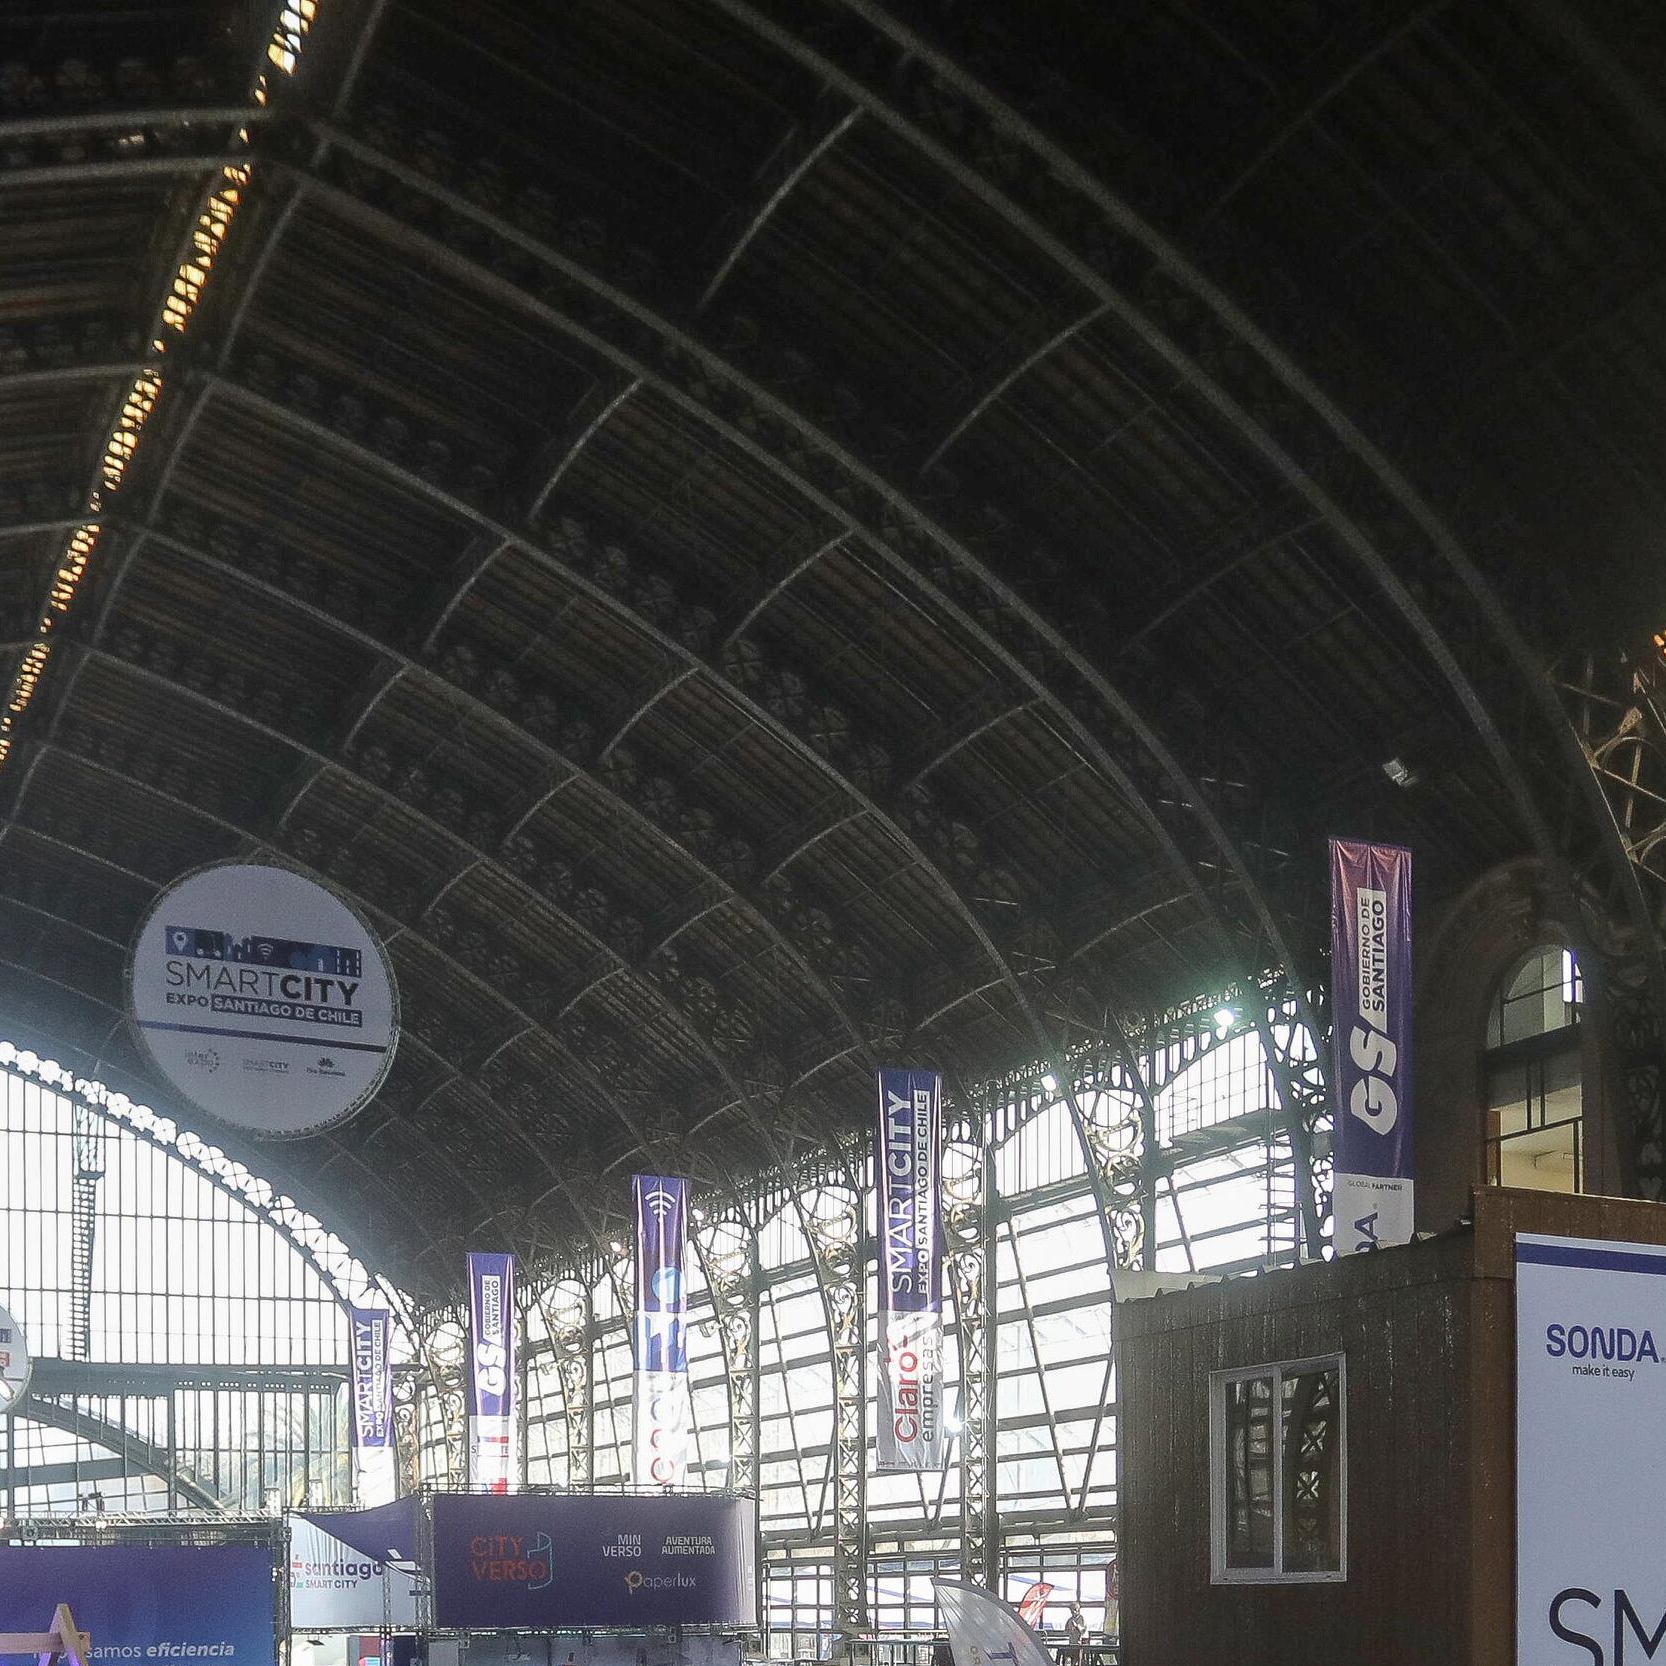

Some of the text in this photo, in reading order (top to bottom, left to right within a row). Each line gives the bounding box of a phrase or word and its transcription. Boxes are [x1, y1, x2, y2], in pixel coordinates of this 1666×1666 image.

[1361, 896, 1371, 1011] GOBIERNO DE
[1372, 899, 1385, 1012] SANTIAGO
[165, 959, 360, 1006] SMARTCITY
[166, 992, 360, 1026] EXPO SANTIAGO DE CHILE
[1349, 1025, 1398, 1136] GS
[887, 1090, 913, 1295] SMARTCITY
[916, 1093, 930, 1295] EXPO SANTIAGO DE CHILE
[492, 1279, 500, 1336] SANTIAGO
[373, 1321, 381, 1347] CHILE
[1545, 1323, 1660, 1364] SONDA
[477, 1342, 507, 1397] GS
[922, 1336, 938, 1443] empresas
[1572, 1363, 1635, 1381] make it easy
[894, 1351, 919, 1443] Claro
[601, 1545, 642, 1558] VERSO
[617, 1533, 642, 1545] MIN
[661, 1545, 717, 1556] AUMENTADA
[664, 1535, 713, 1545] AVENTURA
[305, 1579, 359, 1590] SMART CITY
[472, 1559, 548, 1582] VERSO
[145, 1640, 235, 1659] eficiencia
